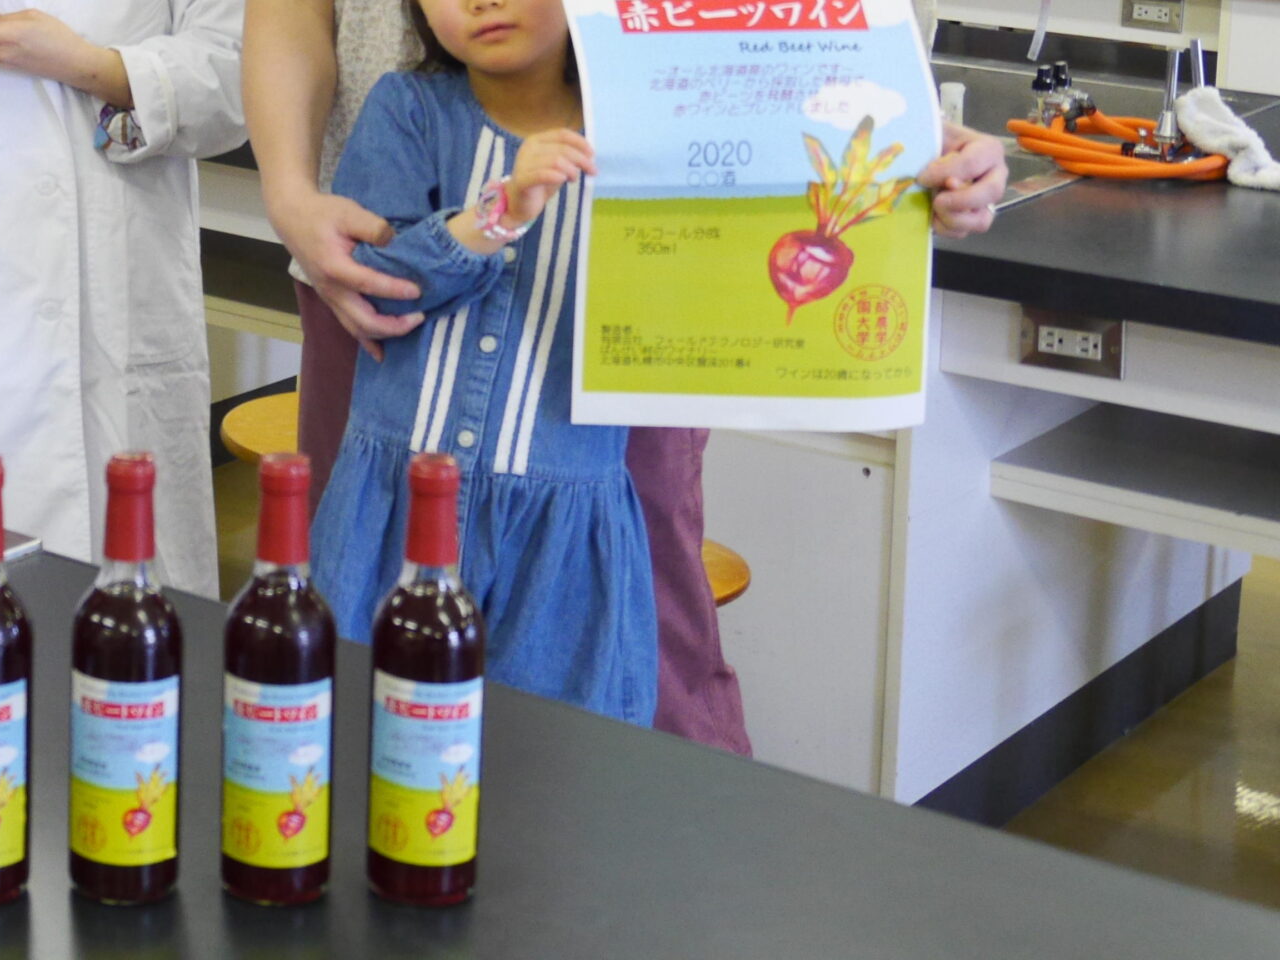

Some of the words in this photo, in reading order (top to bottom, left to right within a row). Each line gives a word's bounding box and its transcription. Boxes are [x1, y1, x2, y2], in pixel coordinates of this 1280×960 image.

[739, 41, 773, 53] Red
[778, 41, 812, 53] Beet
[819, 41, 862, 53] Wine
[688, 140, 752, 167] 2020
